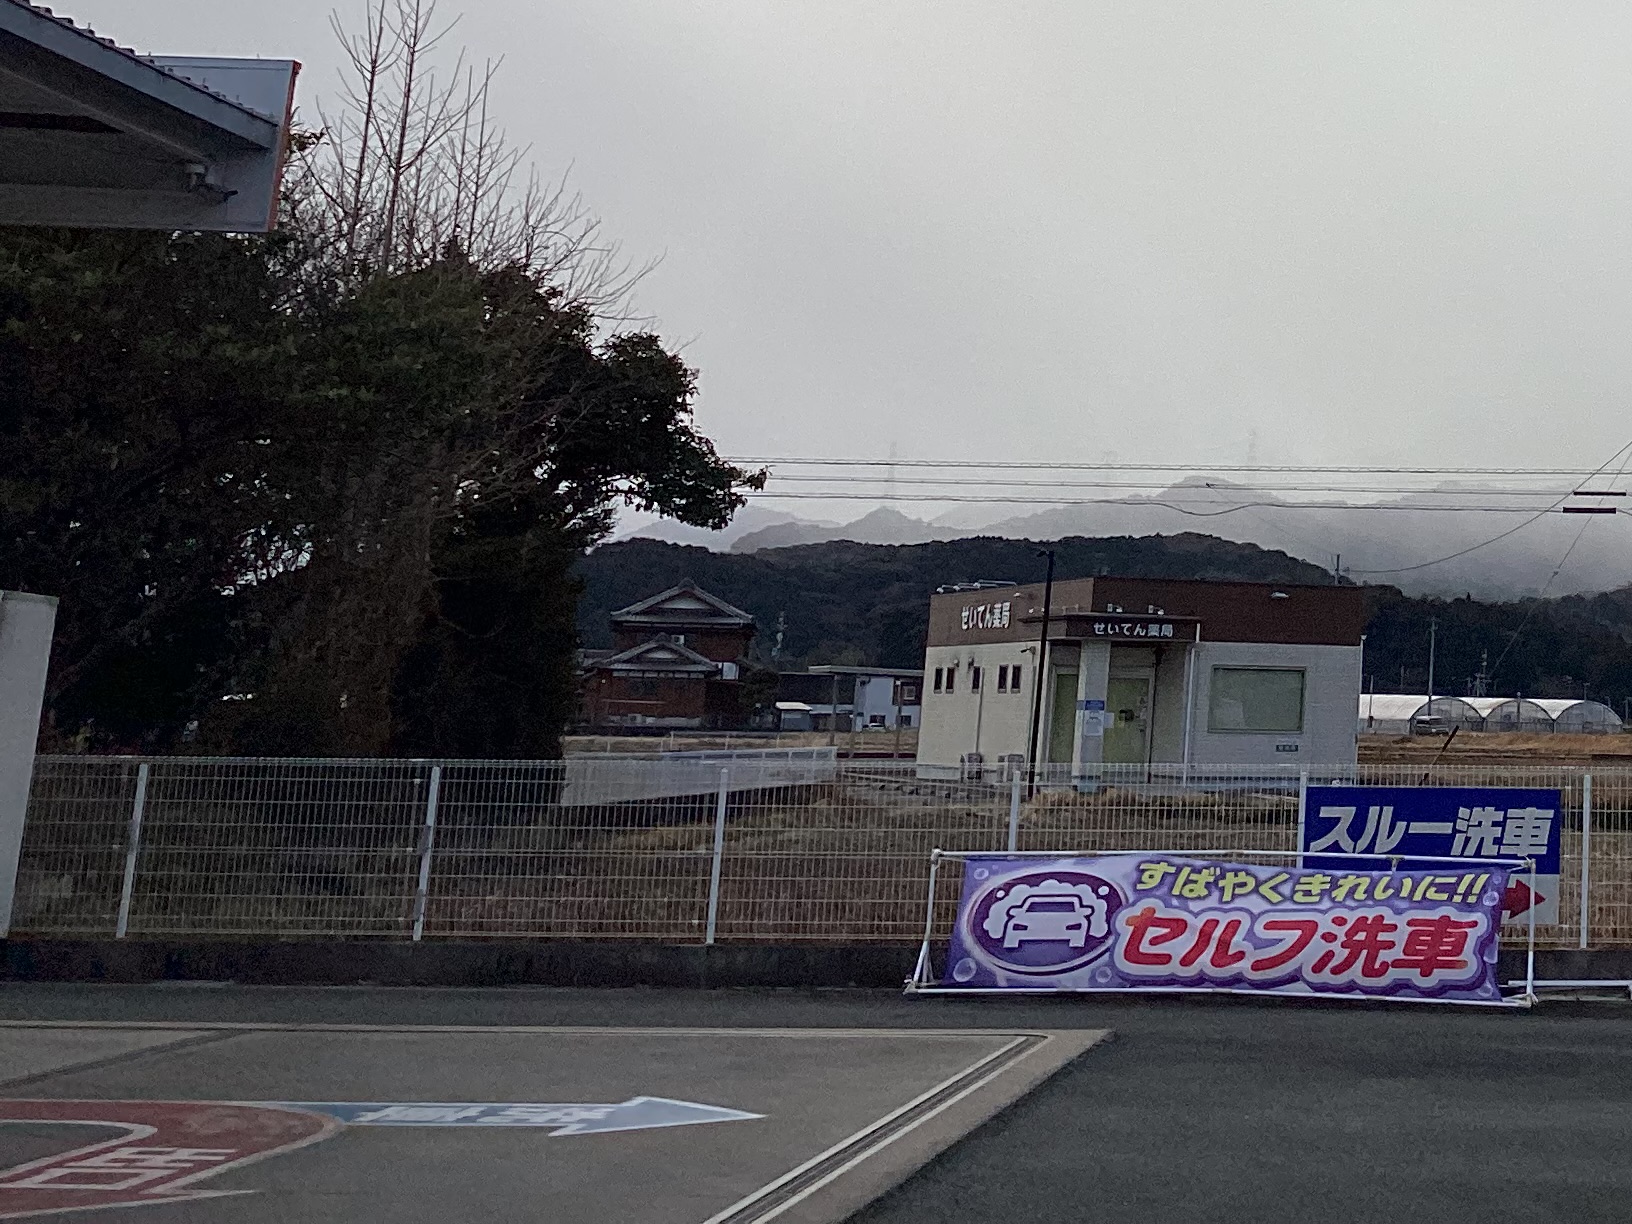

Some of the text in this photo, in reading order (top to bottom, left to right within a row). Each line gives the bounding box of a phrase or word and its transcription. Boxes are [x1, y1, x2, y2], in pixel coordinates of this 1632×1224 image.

[961, 601, 1011, 630] せいてん薬局
[1093, 622, 1174, 638] せいてん薬局
[1309, 806, 1555, 857] スルー洗車
[1136, 860, 1490, 904] すばやくきれいに!!
[1120, 907, 1478, 981] セルフ洗車
